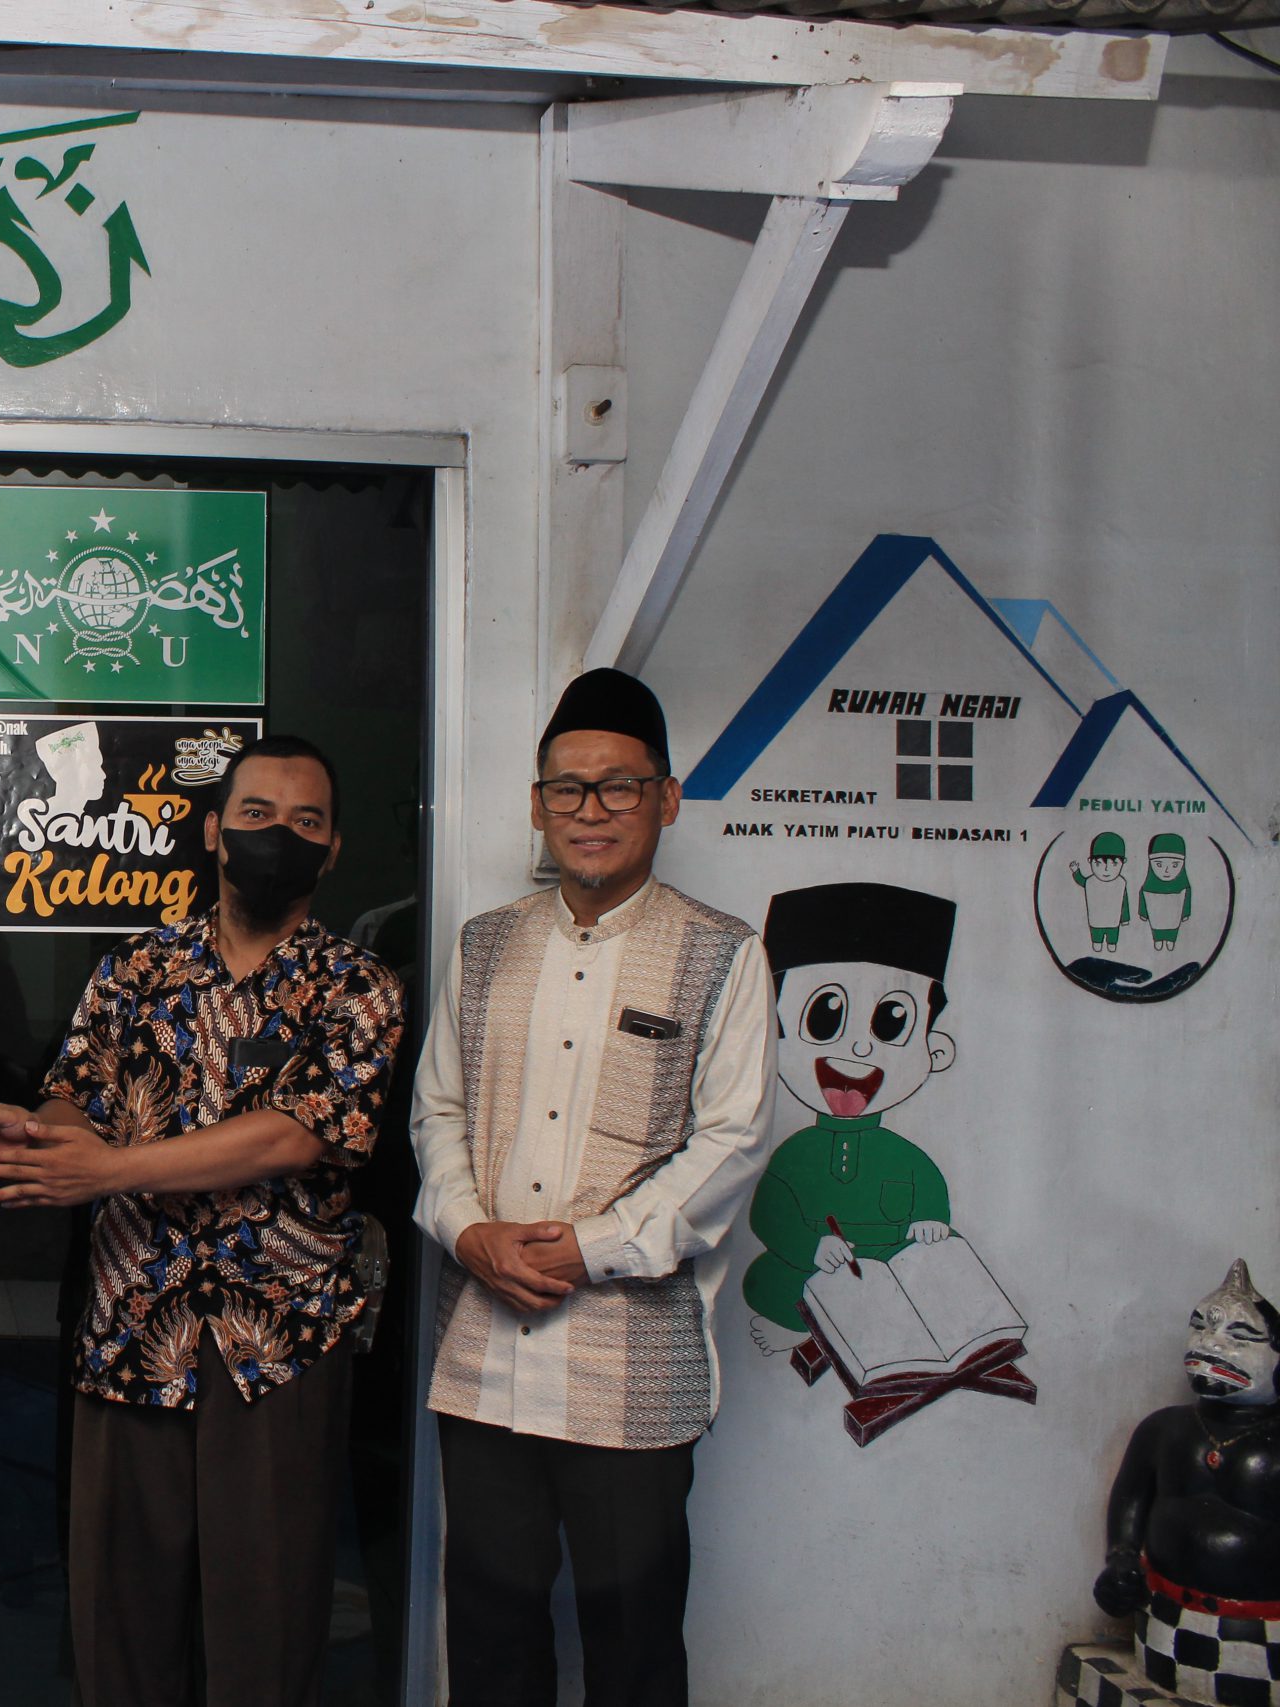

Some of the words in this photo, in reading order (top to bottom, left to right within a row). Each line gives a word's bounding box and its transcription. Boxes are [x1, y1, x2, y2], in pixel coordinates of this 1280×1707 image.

[13, 633, 44, 665] N
[159, 636, 190, 667] U
[827, 688, 926, 717] RUMAH
[941, 693, 1022, 720] NGAJI
[750, 788, 878, 805] SEKRETARIAT
[1079, 798, 1144, 813] PEDULI
[1150, 799, 1207, 814] YATIM
[17, 798, 176, 856] Santri
[723, 823, 774, 837] ANAK
[783, 824, 839, 838] YATIM
[847, 825, 900, 839] PIATU
[911, 827, 1011, 842] BENDASARI
[1019, 830, 1028, 842] 1
[3, 850, 198, 925] Kalong
